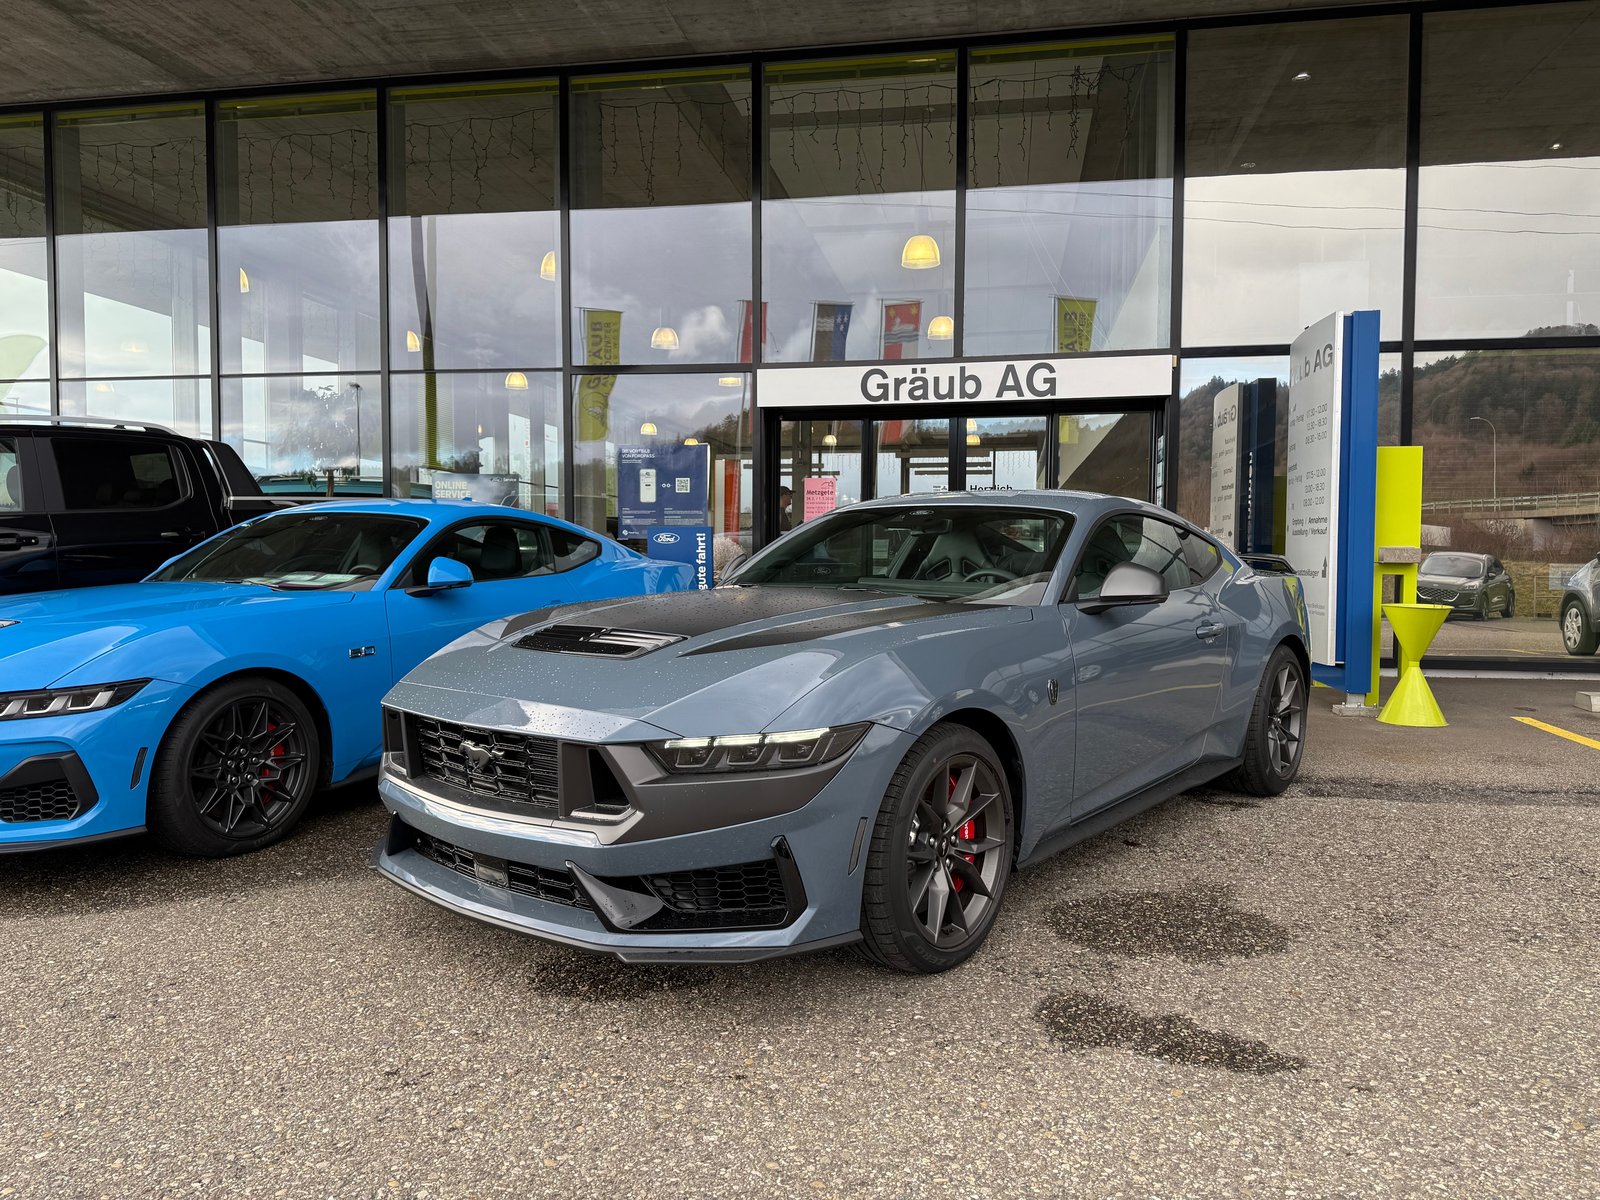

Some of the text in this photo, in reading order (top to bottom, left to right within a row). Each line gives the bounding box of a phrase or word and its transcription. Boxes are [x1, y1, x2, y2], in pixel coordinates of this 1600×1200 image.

[587, 321, 603, 389] GÄUB
[1313, 343, 1333, 373] AG
[861, 362, 1057, 401] Gräub AG
[434, 481, 468, 490] ONLINE
[434, 490, 472, 499] SERVICE
[657, 533, 676, 543] Ford
[696, 533, 706, 565] fahrt!
